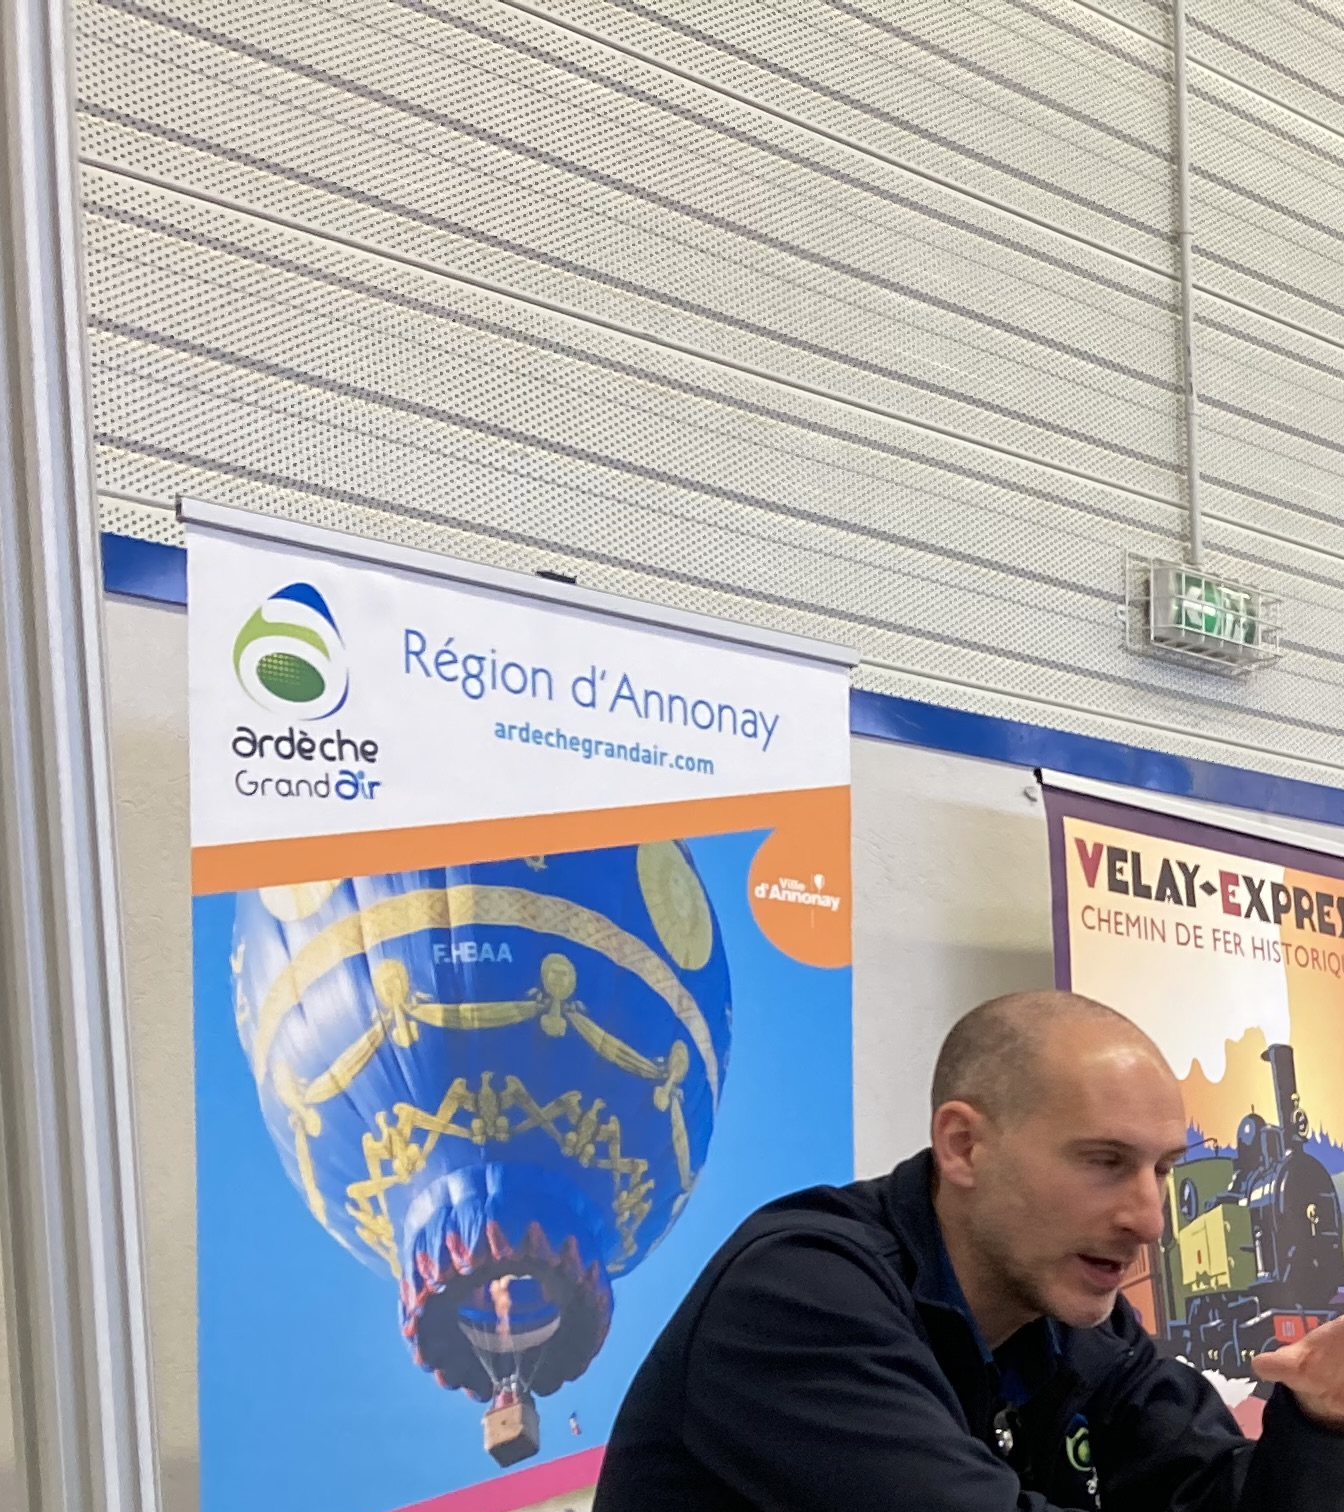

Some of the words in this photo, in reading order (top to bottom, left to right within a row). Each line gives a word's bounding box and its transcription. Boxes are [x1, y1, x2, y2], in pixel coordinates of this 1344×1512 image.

[403, 628, 554, 701] Région
[571, 667, 781, 753] d'Annonay
[231, 726, 379, 763] ardèche
[493, 718, 715, 776] ardechegrandair.com
[754, 881, 841, 912] d'Annonay
[1081, 904, 1167, 944] CHEMIN
[1175, 922, 1204, 949] DE
[1212, 928, 1246, 958] FER
